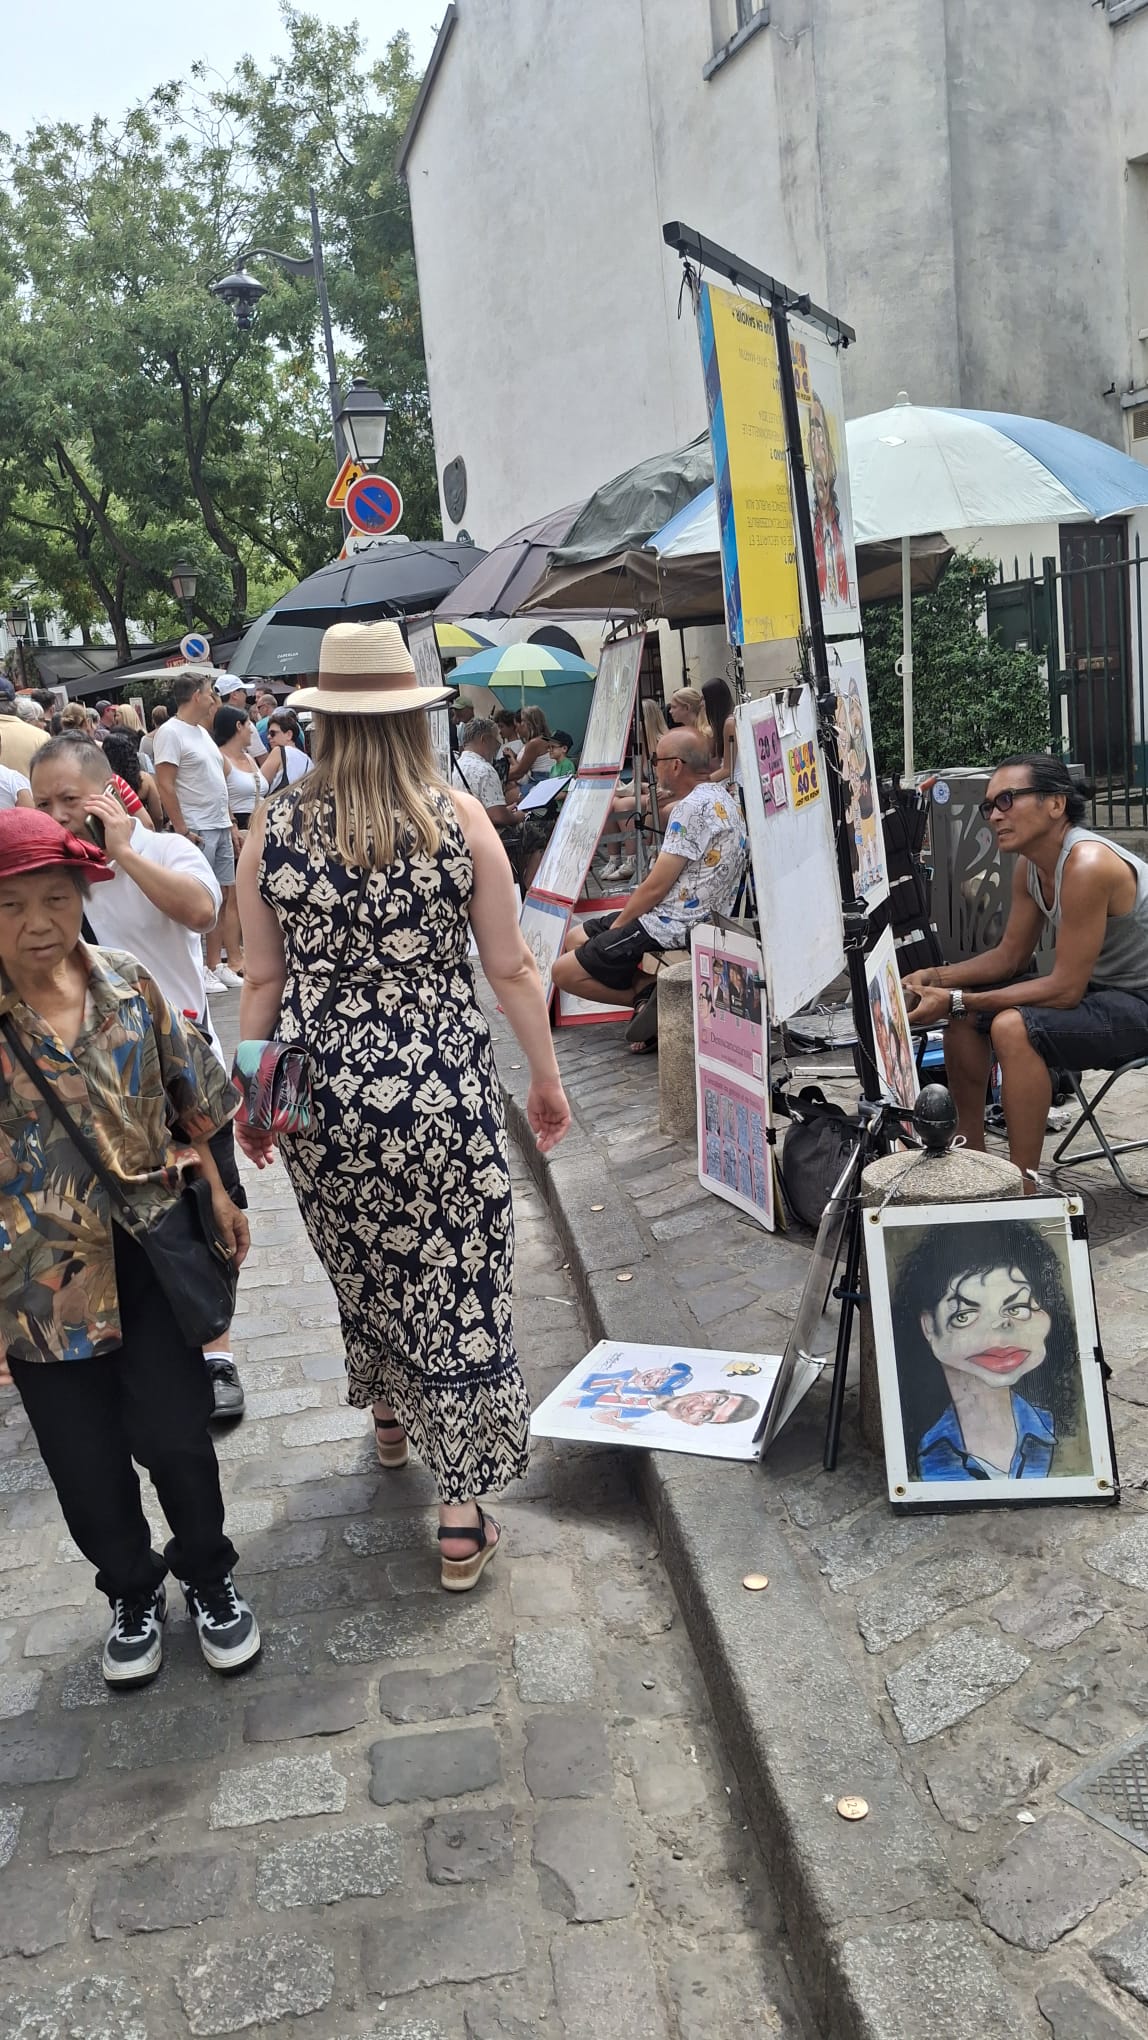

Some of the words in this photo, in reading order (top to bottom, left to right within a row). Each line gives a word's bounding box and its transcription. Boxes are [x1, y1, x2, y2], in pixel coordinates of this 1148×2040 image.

[759, 736, 770, 760] 20
[788, 741, 815, 775] COLOR
[797, 771, 809, 795] 40
[810, 767, 817, 788] €
